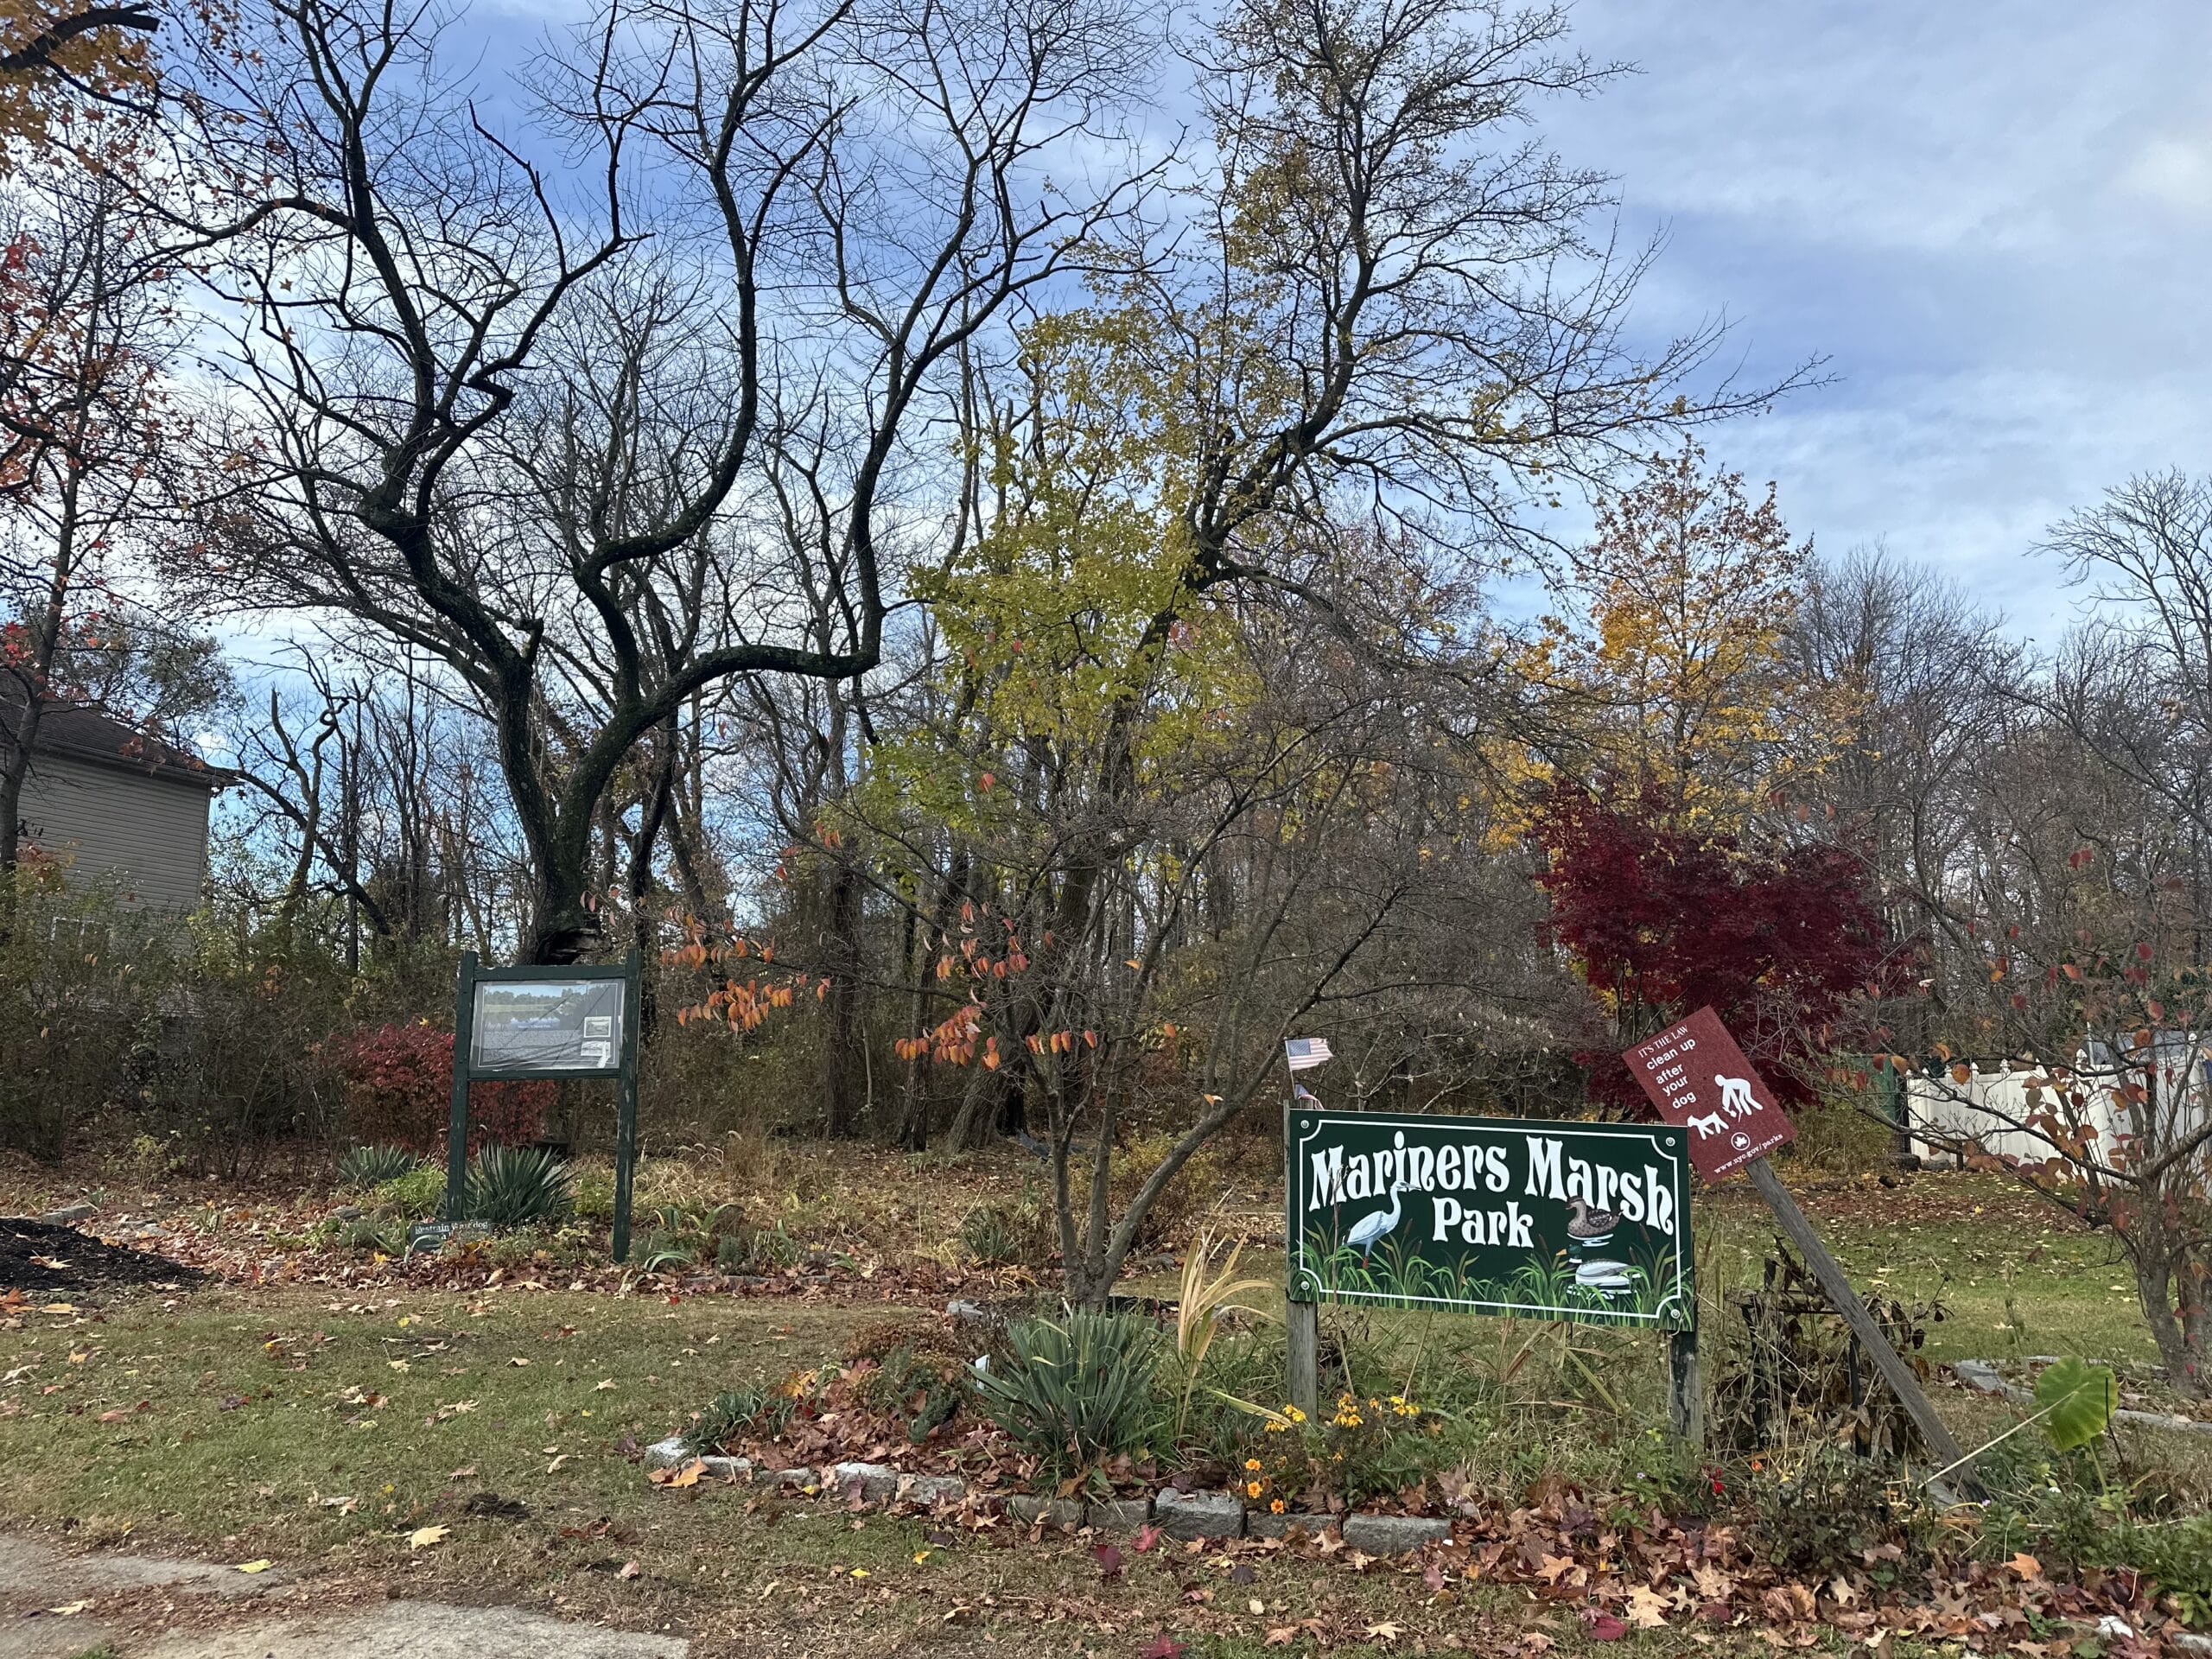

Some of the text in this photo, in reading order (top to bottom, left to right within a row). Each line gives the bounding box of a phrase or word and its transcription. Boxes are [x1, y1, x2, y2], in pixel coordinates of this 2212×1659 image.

[1653, 1034, 1672, 1049] THE
[1670, 1025, 1688, 1040] LAW
[1646, 1039, 1696, 1070] clean up
[1656, 1064, 1684, 1084] after
[1662, 1075, 1688, 1096] your
[1672, 1091, 1697, 1109] dog
[1713, 1134, 1783, 1174] www.nyc.gov/parks
[1308, 1130, 1674, 1236] Mariners Marsh
[1431, 1197, 1535, 1249] Park
